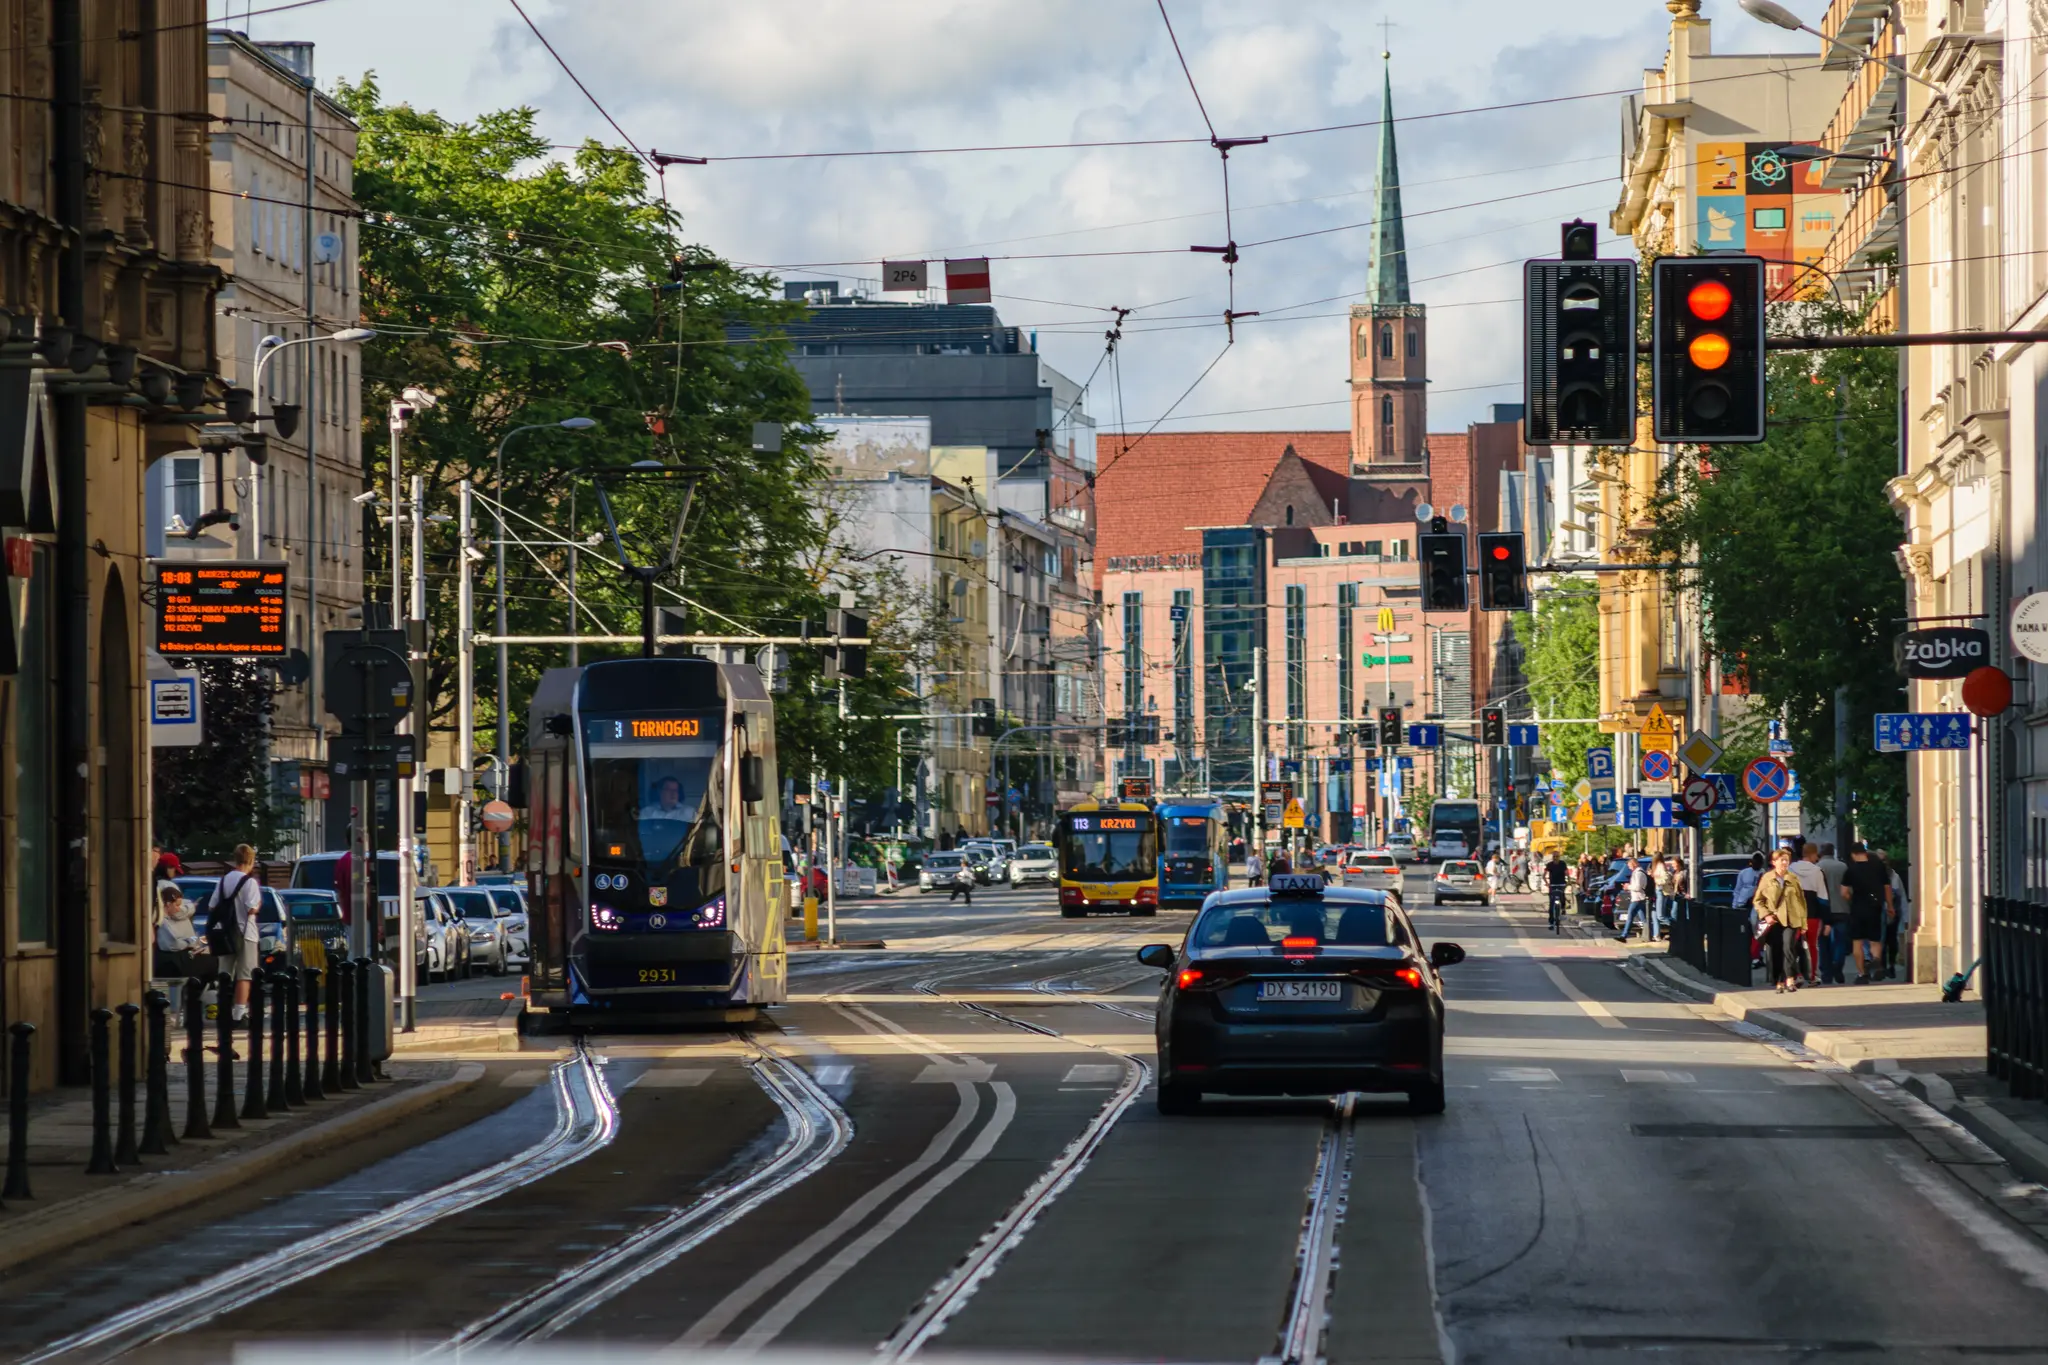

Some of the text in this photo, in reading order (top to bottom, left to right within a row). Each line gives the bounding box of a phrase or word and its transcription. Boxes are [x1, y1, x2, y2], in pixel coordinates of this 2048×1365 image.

[893, 270, 917, 282] 2P6
[2016, 623, 2039, 633] MAMA
[1905, 638, 1981, 660] żabka
[631, 720, 699, 737] TARNOGAJ
[1074, 818, 1136, 829] 113 KRZYKI
[1278, 878, 1316, 889] TAXI
[638, 969, 676, 982] 2931
[1266, 982, 1338, 996] DX 54190
